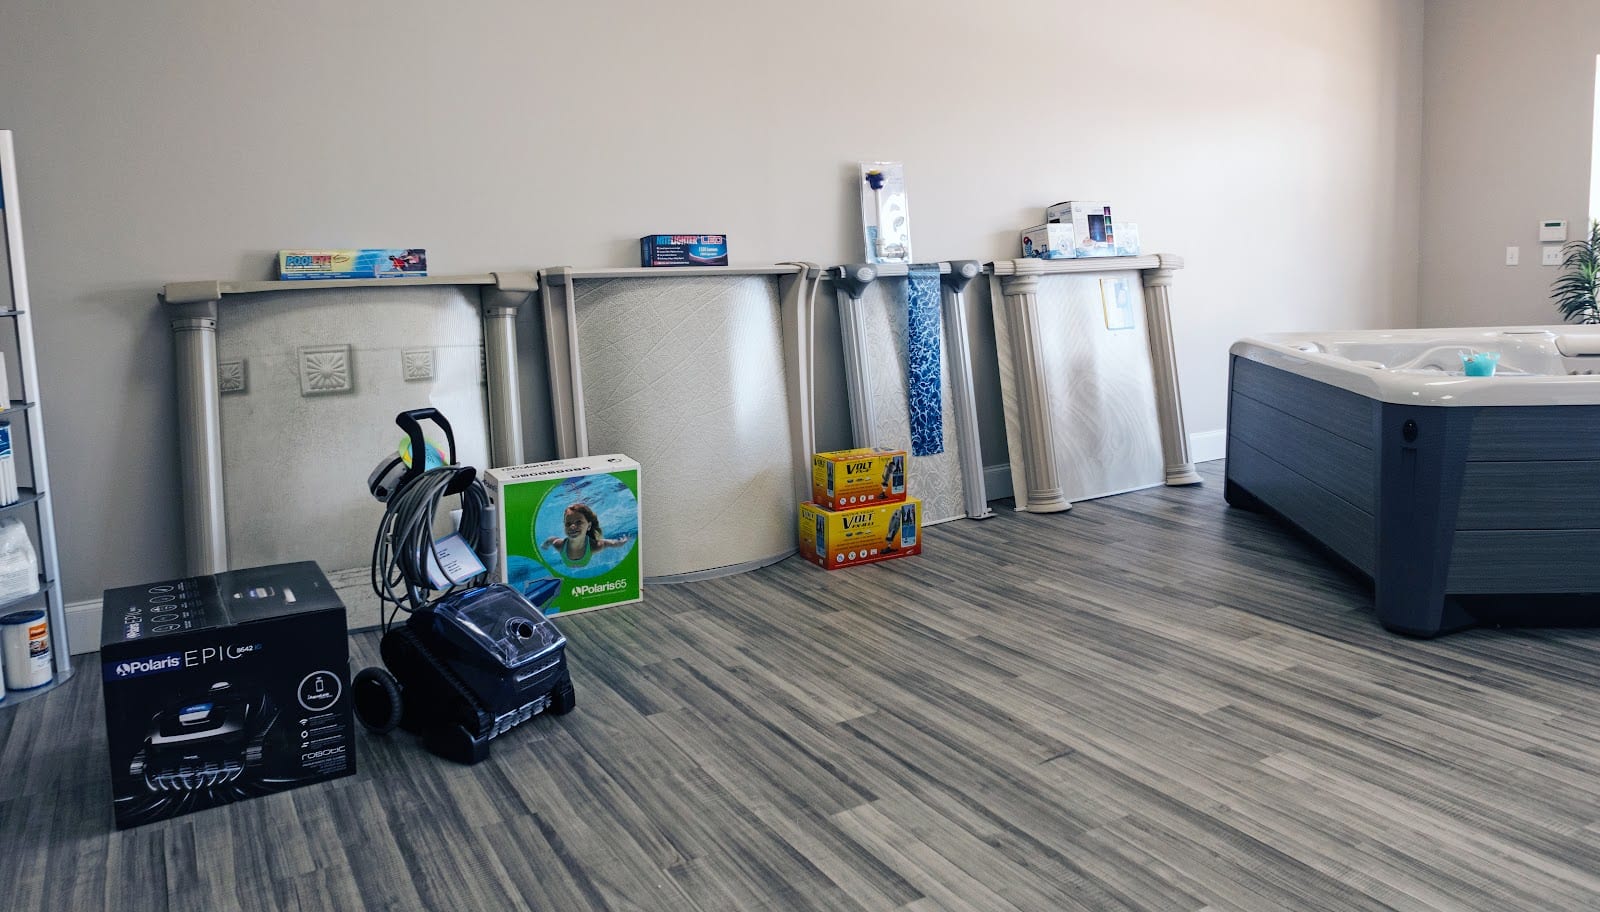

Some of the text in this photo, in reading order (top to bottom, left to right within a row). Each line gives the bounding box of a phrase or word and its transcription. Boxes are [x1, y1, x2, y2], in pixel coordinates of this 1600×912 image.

[846, 461, 873, 475] VOLT
[842, 513, 873, 529] VOLT
[130, 656, 180, 674] Polaris
[184, 645, 242, 667] EPIC
